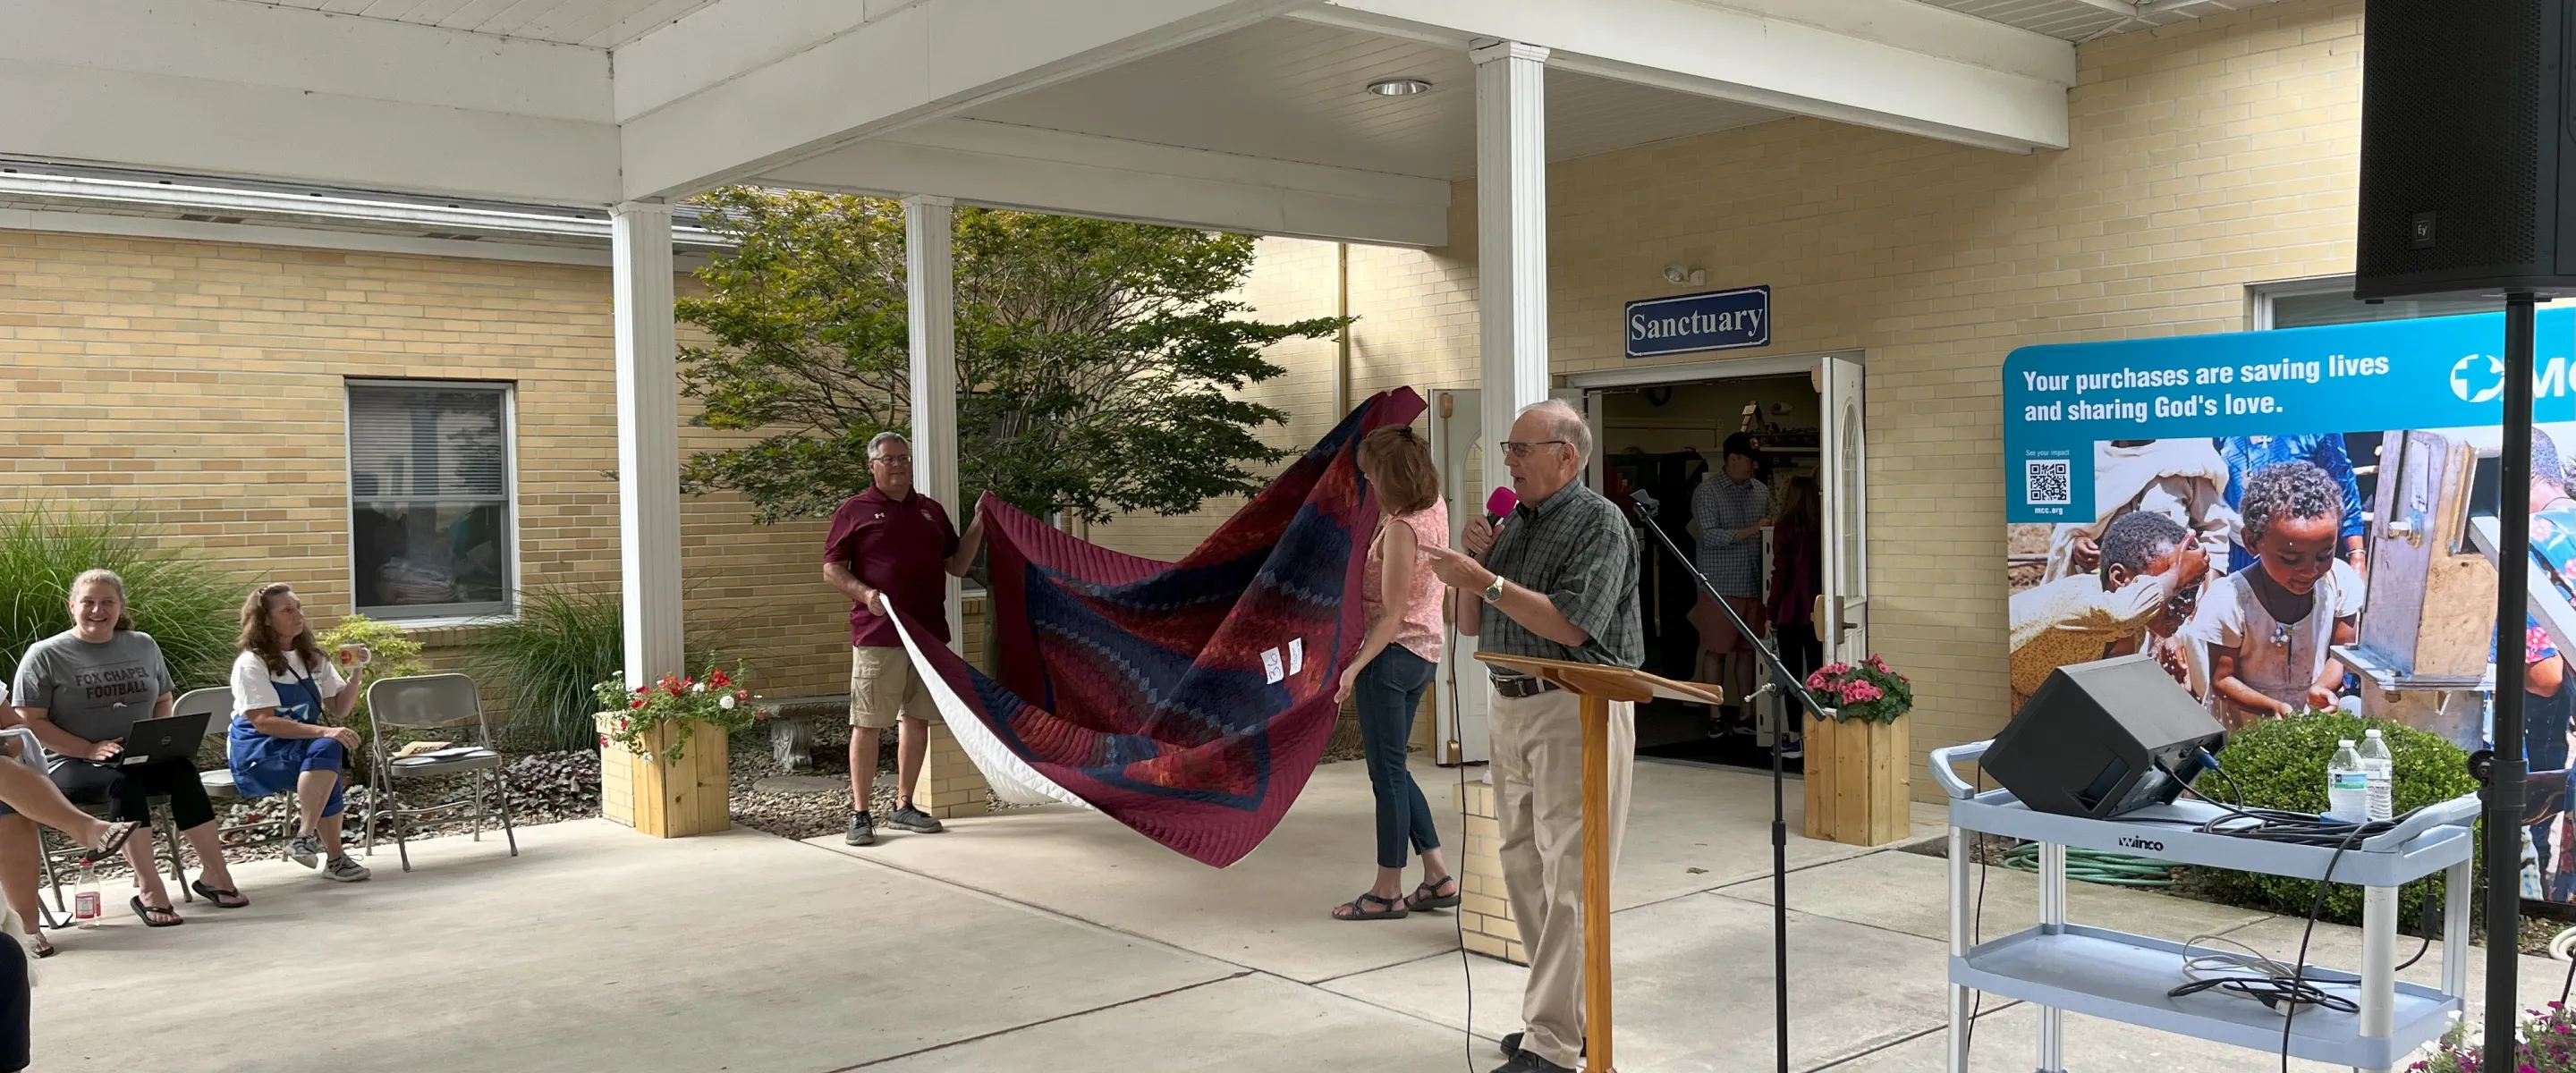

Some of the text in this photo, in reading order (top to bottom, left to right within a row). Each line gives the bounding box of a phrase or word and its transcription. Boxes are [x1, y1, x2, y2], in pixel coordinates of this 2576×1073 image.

[1631, 308, 1763, 341] Sanctuary
[2023, 354, 2390, 394] Your purchases are saving lives
[2532, 357, 2576, 398] M
[2024, 393, 2284, 423] and sharing God's love.
[2050, 449, 2070, 457] impact
[2034, 507, 2063, 515] mcc.org
[74, 666, 149, 687] FOX CHAPEL
[1267, 653, 1282, 680] 36
[86, 680, 148, 699] FOOTBALL
